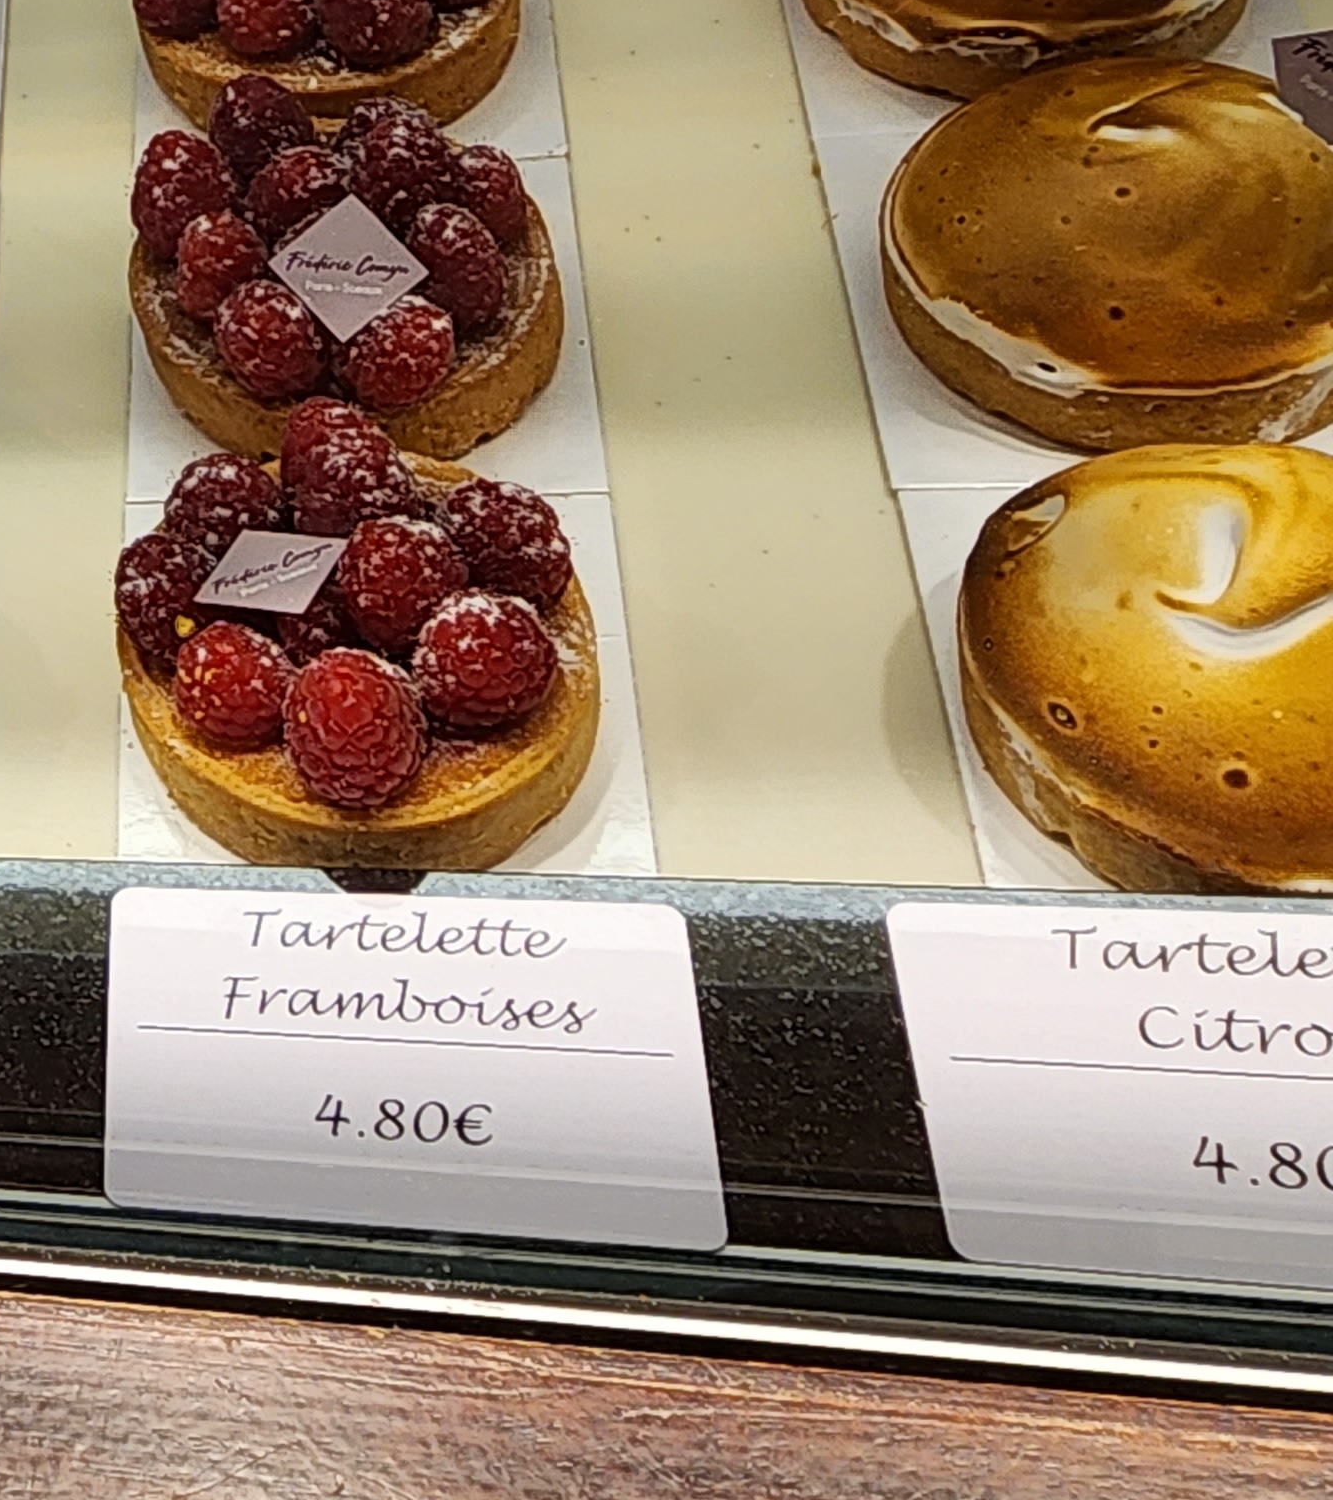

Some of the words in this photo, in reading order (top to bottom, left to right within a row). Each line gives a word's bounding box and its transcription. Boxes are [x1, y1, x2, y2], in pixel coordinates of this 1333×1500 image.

[242, 907, 568, 959] Tartelette
[222, 975, 598, 1036] Framboises
[1137, 1005, 1333, 1058] Citro
[314, 1093, 495, 1147] 4.80€
